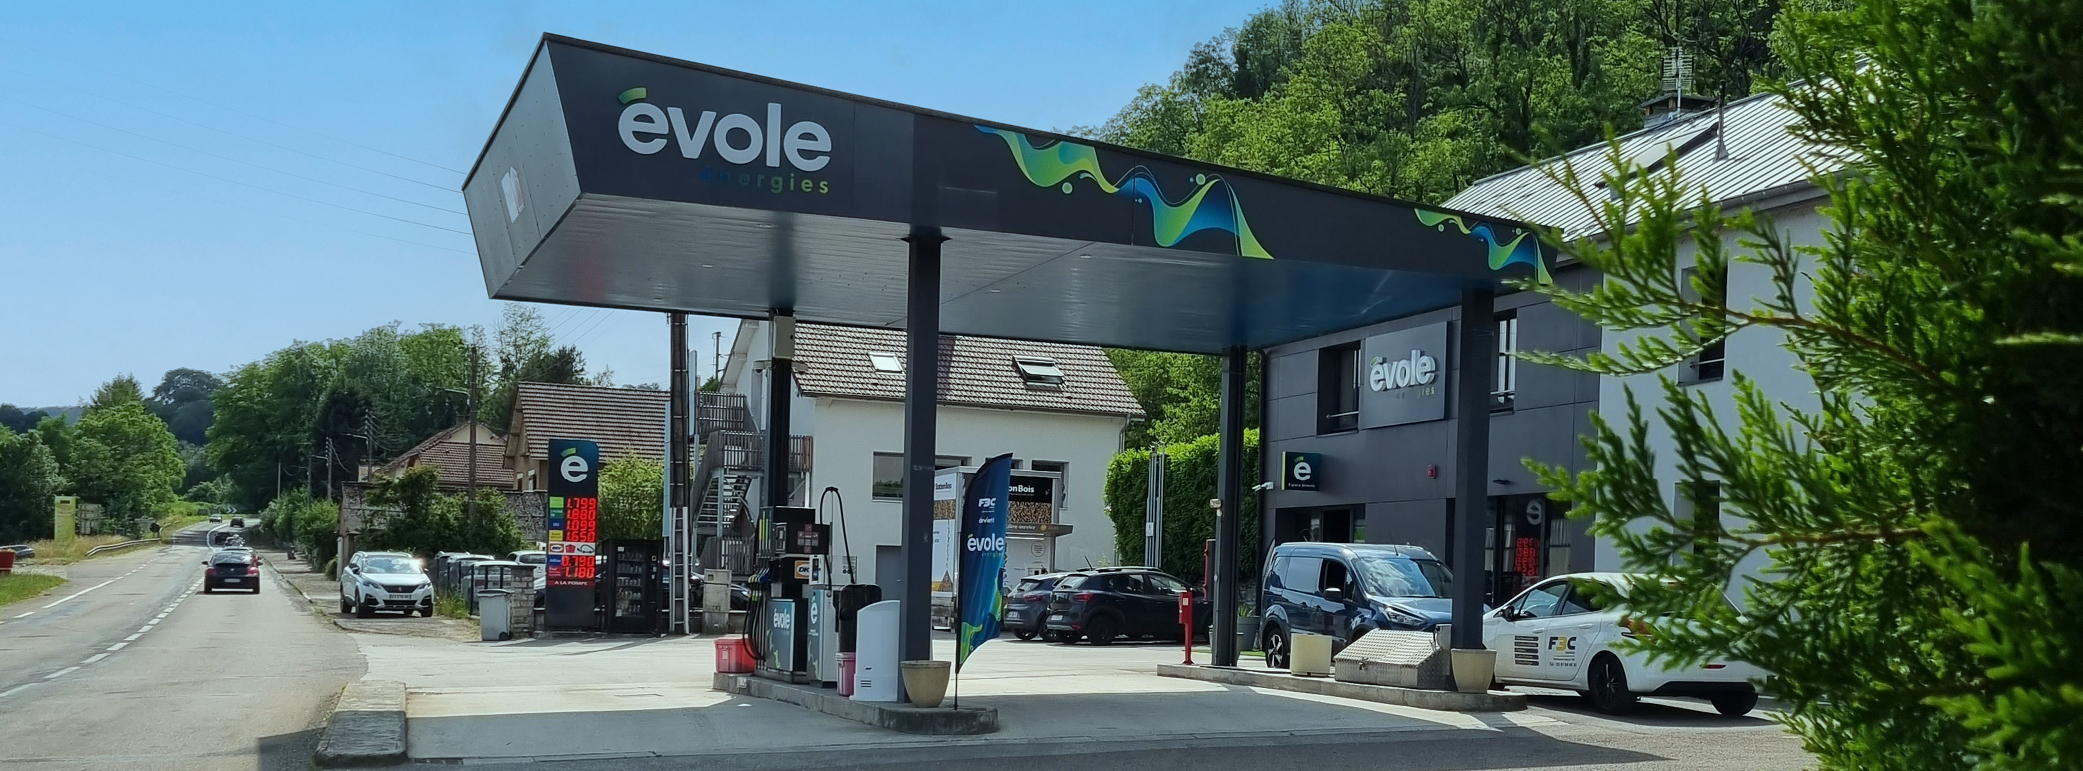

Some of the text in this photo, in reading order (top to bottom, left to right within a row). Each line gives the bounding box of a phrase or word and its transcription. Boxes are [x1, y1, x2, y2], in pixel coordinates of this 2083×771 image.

[617, 87, 832, 171] évole
[701, 165, 829, 193] énergies
[1369, 349, 1436, 392] évole
[567, 497, 597, 509] 1.799
[978, 497, 997, 508] F3C
[567, 509, 596, 520] 1.880
[566, 520, 596, 531] 1.099
[566, 531, 596, 542] 1.650
[967, 532, 1005, 551] évole
[562, 555, 595, 567] 0.790
[773, 608, 791, 629] évole
[1548, 636, 1577, 651] F3C
